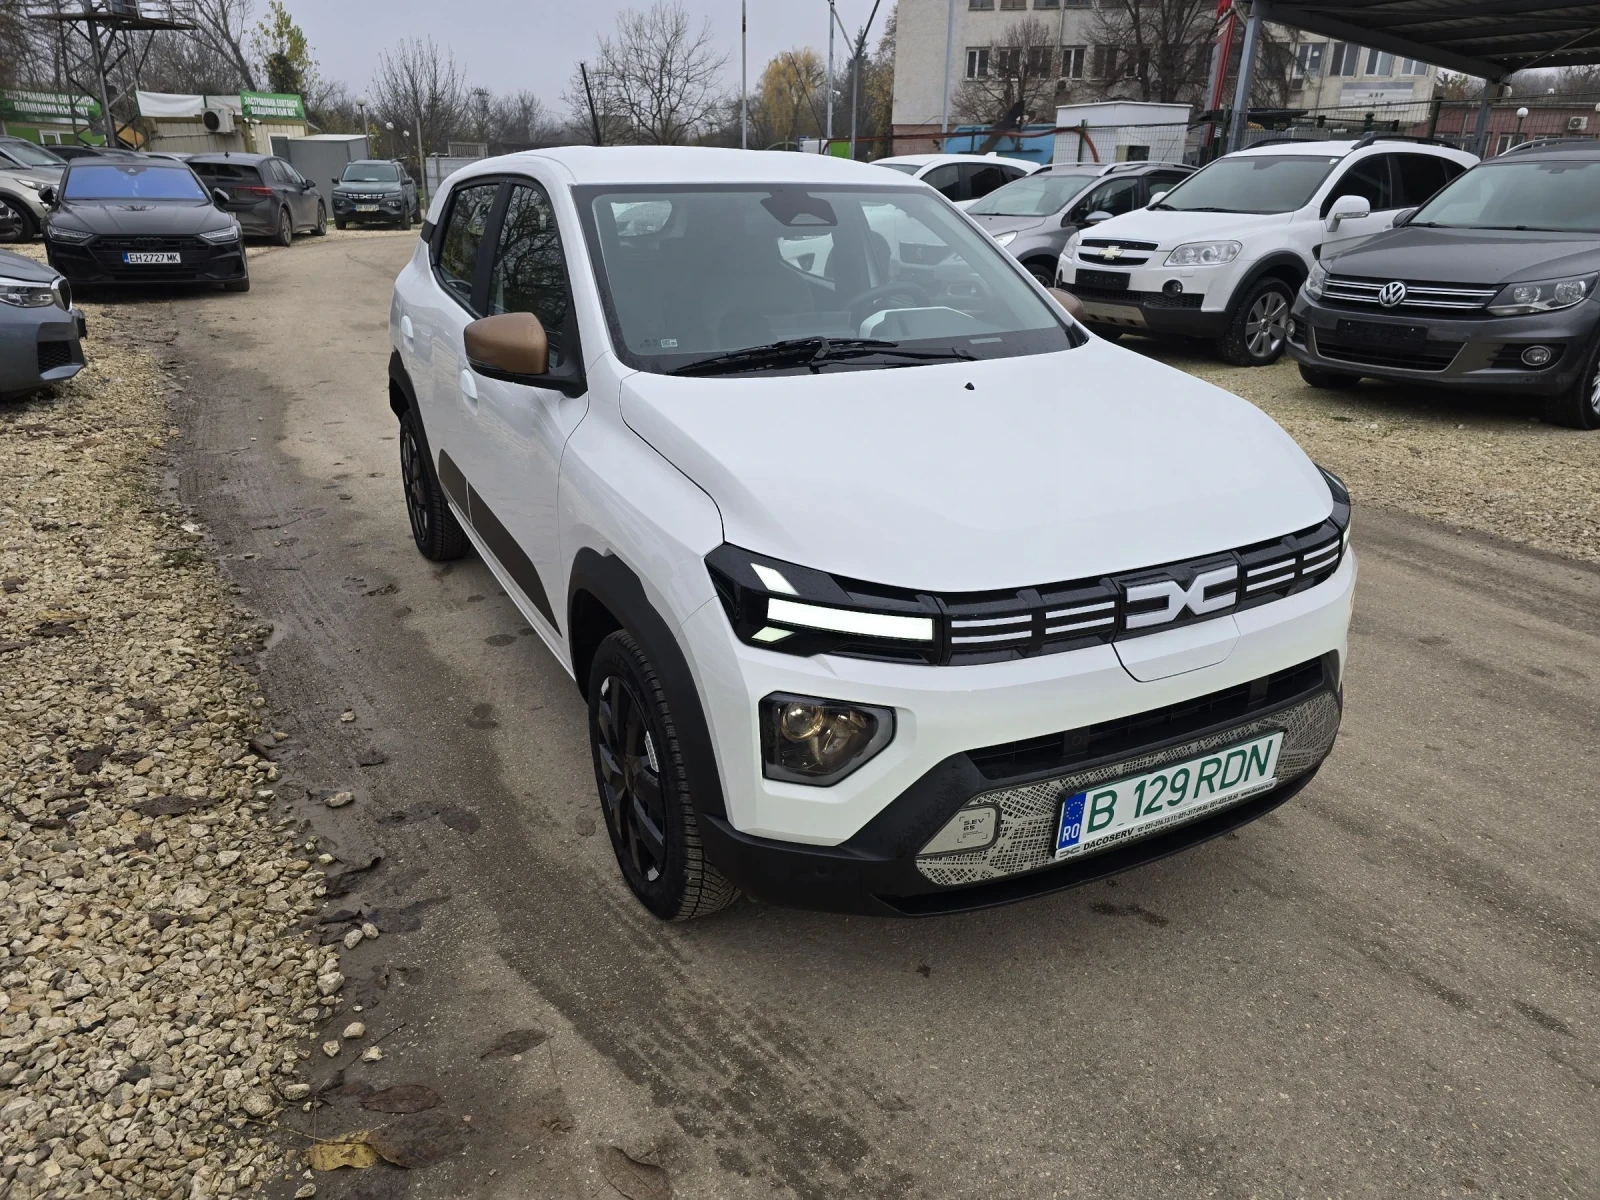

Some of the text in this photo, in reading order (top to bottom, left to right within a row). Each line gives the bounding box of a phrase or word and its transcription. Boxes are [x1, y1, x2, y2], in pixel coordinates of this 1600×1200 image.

[129, 254, 142, 263] EH
[143, 254, 165, 263] 2727
[166, 254, 178, 263] MK
[1086, 739, 1274, 834] B 129 RDN
[1062, 823, 1080, 842] RO
[1083, 827, 1135, 851] DACOSERV
